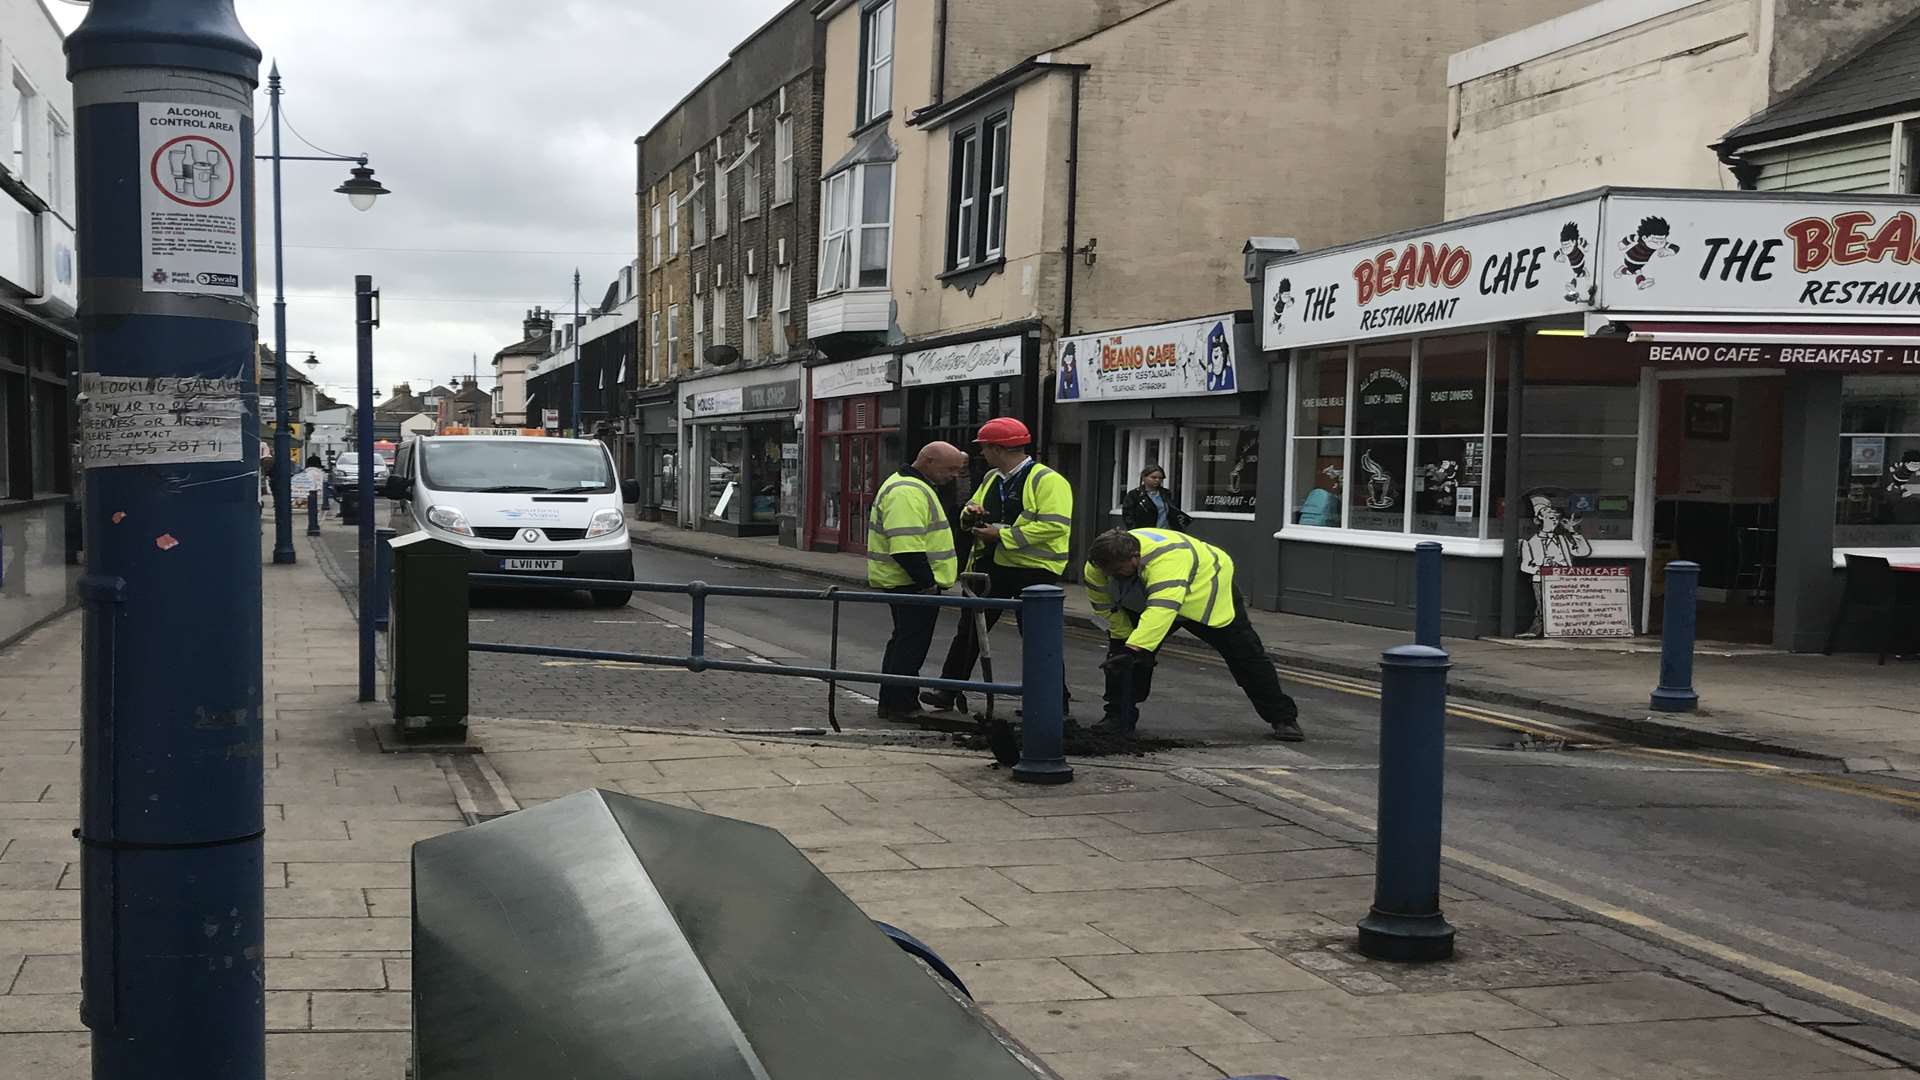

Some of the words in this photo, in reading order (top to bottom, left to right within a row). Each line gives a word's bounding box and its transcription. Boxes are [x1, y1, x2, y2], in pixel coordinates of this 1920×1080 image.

[167, 107, 221, 119] ALCOHOL
[150, 117, 207, 128] CONTROL
[208, 121, 234, 132] AREA
[1699, 237, 1784, 283] THE
[1784, 210, 1920, 274] BEA
[211, 274, 237, 284] Swale
[1303, 283, 1339, 323] THE
[1352, 241, 1472, 307] BEANO
[1479, 246, 1546, 296] CAFE
[1360, 297, 1460, 331] RESTAURANT
[1109, 336, 1122, 345] THE
[1103, 344, 1144, 373] BEANO
[1146, 344, 1177, 368] CAFE
[1649, 346, 1709, 361] BEANO
[1714, 347, 1761, 362] CAFE
[1779, 348, 1884, 363] BREAKFAST
[1116, 372, 1132, 382] BEST
[1136, 369, 1176, 380] RESTAURANT
[1431, 391, 1448, 401] ROAST
[1450, 390, 1473, 401] DINNERS
[148, 402, 165, 411] TO
[144, 418, 165, 428] OR
[120, 430, 172, 439] CONTACT
[167, 441, 200, 453] 287
[208, 440, 222, 453] 91
[1205, 495, 1244, 506] RESTAURANT
[535, 560, 557, 569] NVT
[1552, 567, 1592, 576] BEANO
[1594, 567, 1625, 576] CAFE
[1561, 628, 1593, 636] BEANO
[1596, 628, 1623, 636] CAFE
